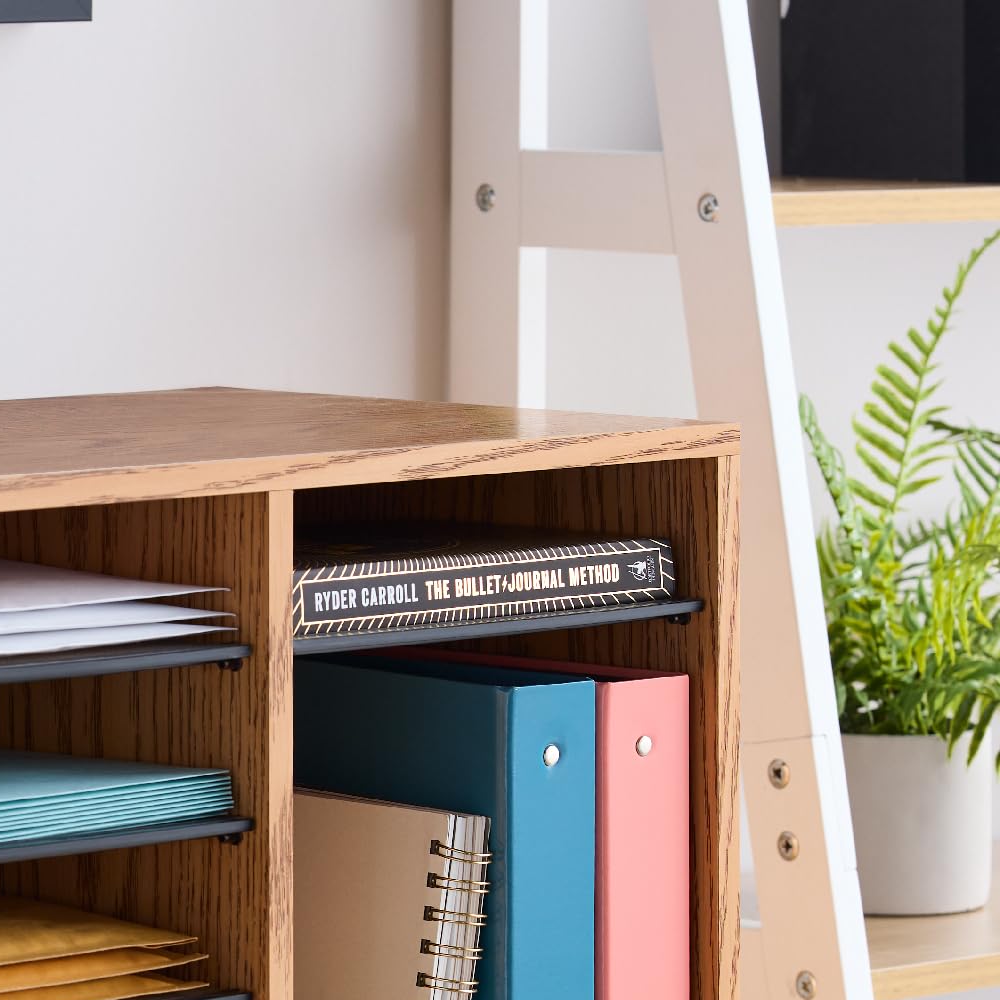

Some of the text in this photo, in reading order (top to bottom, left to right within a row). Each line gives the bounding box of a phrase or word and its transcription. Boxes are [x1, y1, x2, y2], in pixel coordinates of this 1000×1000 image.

[314, 589, 357, 612] RYDER
[361, 583, 419, 607] CARROLL
[425, 579, 451, 601] THE
[454, 574, 502, 598] BULLET
[507, 568, 566, 593] JOURNAL
[569, 563, 620, 587] METHOD
